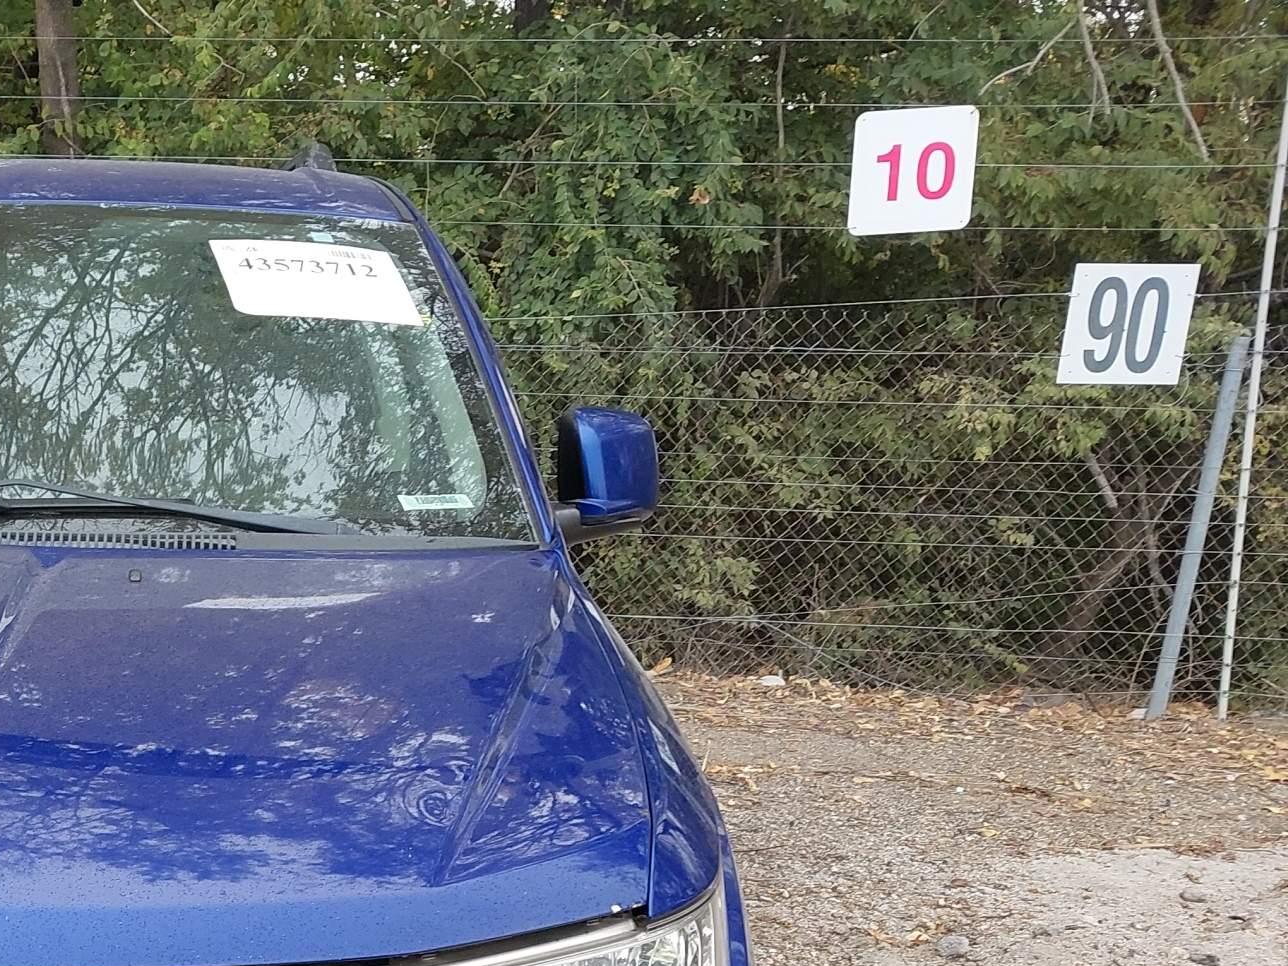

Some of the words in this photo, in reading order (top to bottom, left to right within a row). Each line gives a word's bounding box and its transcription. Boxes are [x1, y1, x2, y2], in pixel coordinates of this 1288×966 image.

[876, 141, 956, 202] 10
[238, 257, 378, 278] 43573712
[1082, 276, 1170, 374] 90
